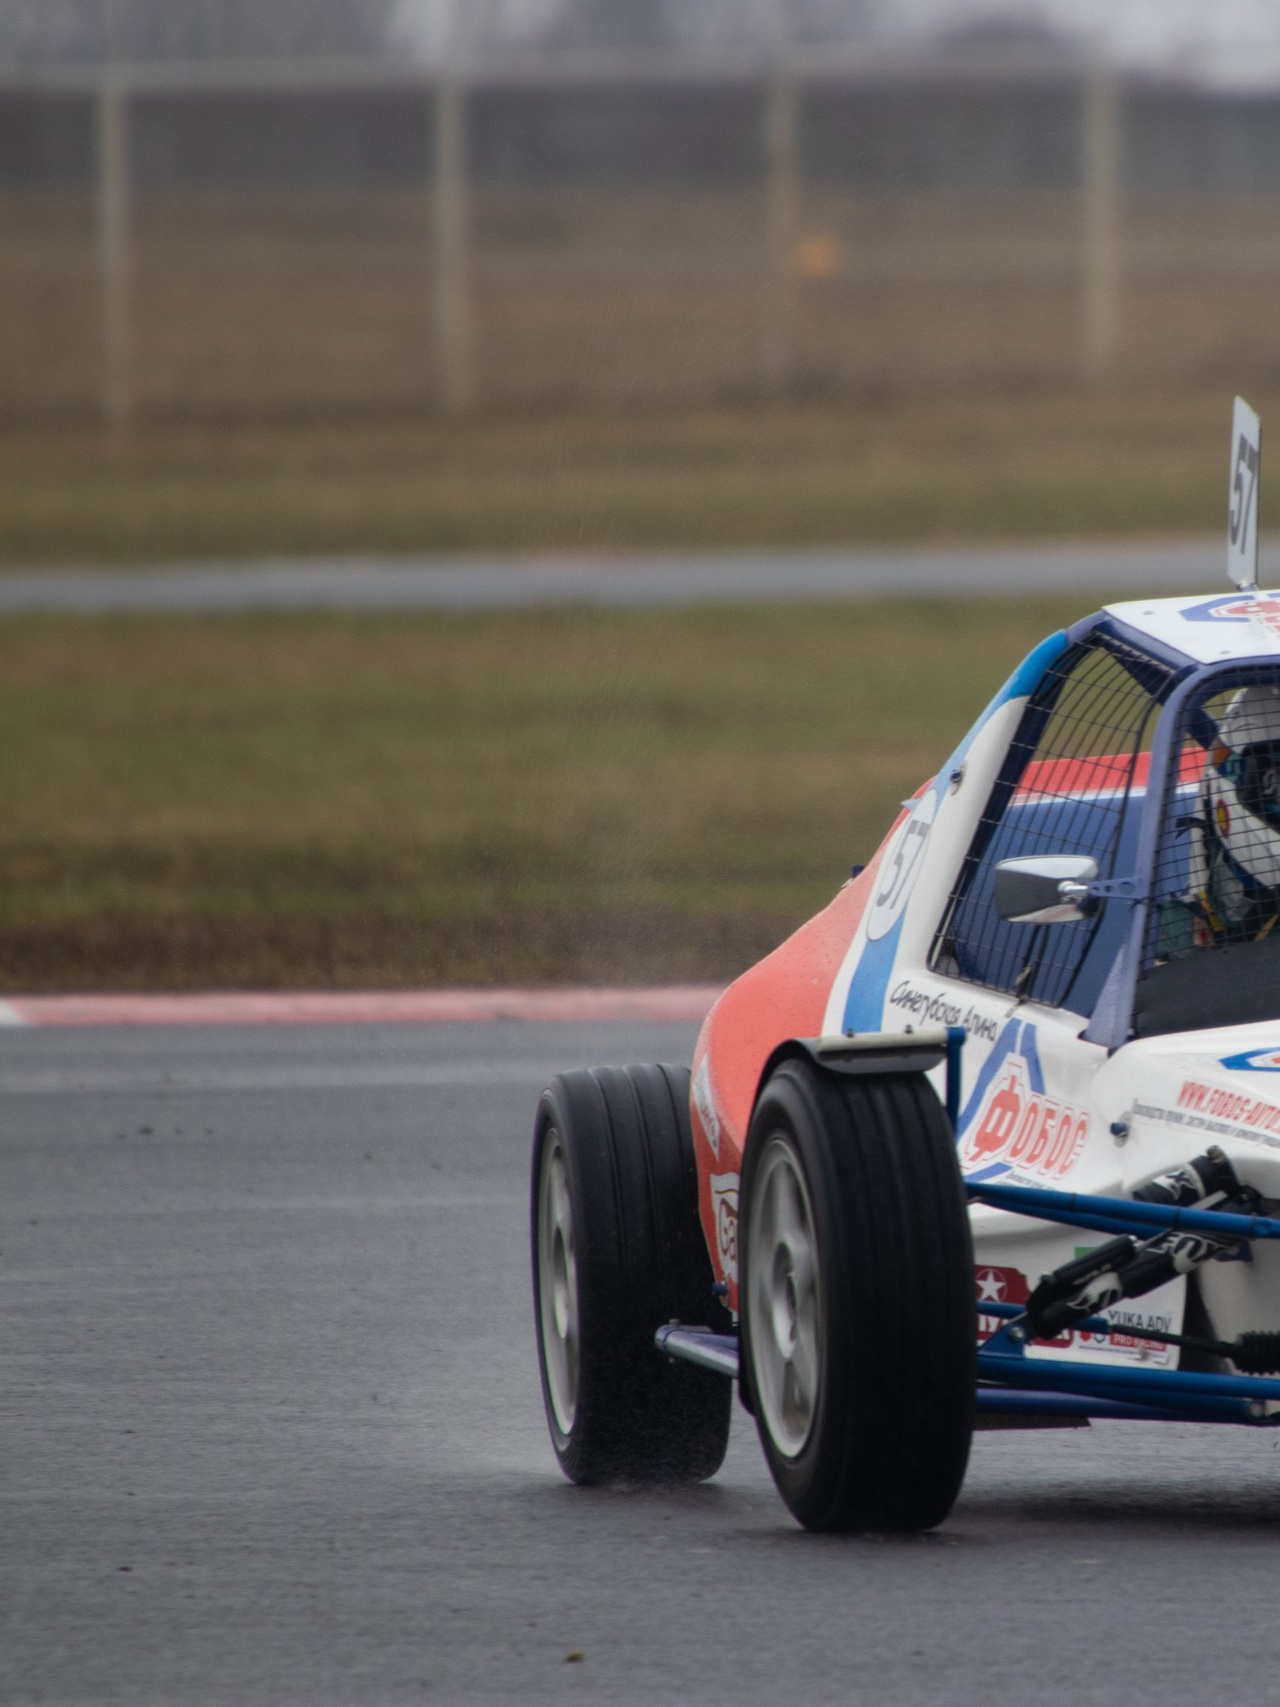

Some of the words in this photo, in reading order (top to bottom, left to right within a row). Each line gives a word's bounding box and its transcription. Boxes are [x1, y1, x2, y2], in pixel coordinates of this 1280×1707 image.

[1230, 433, 1259, 555] 57
[875, 819, 931, 910] 57
[960, 1060, 1090, 1178] ФОБОС
